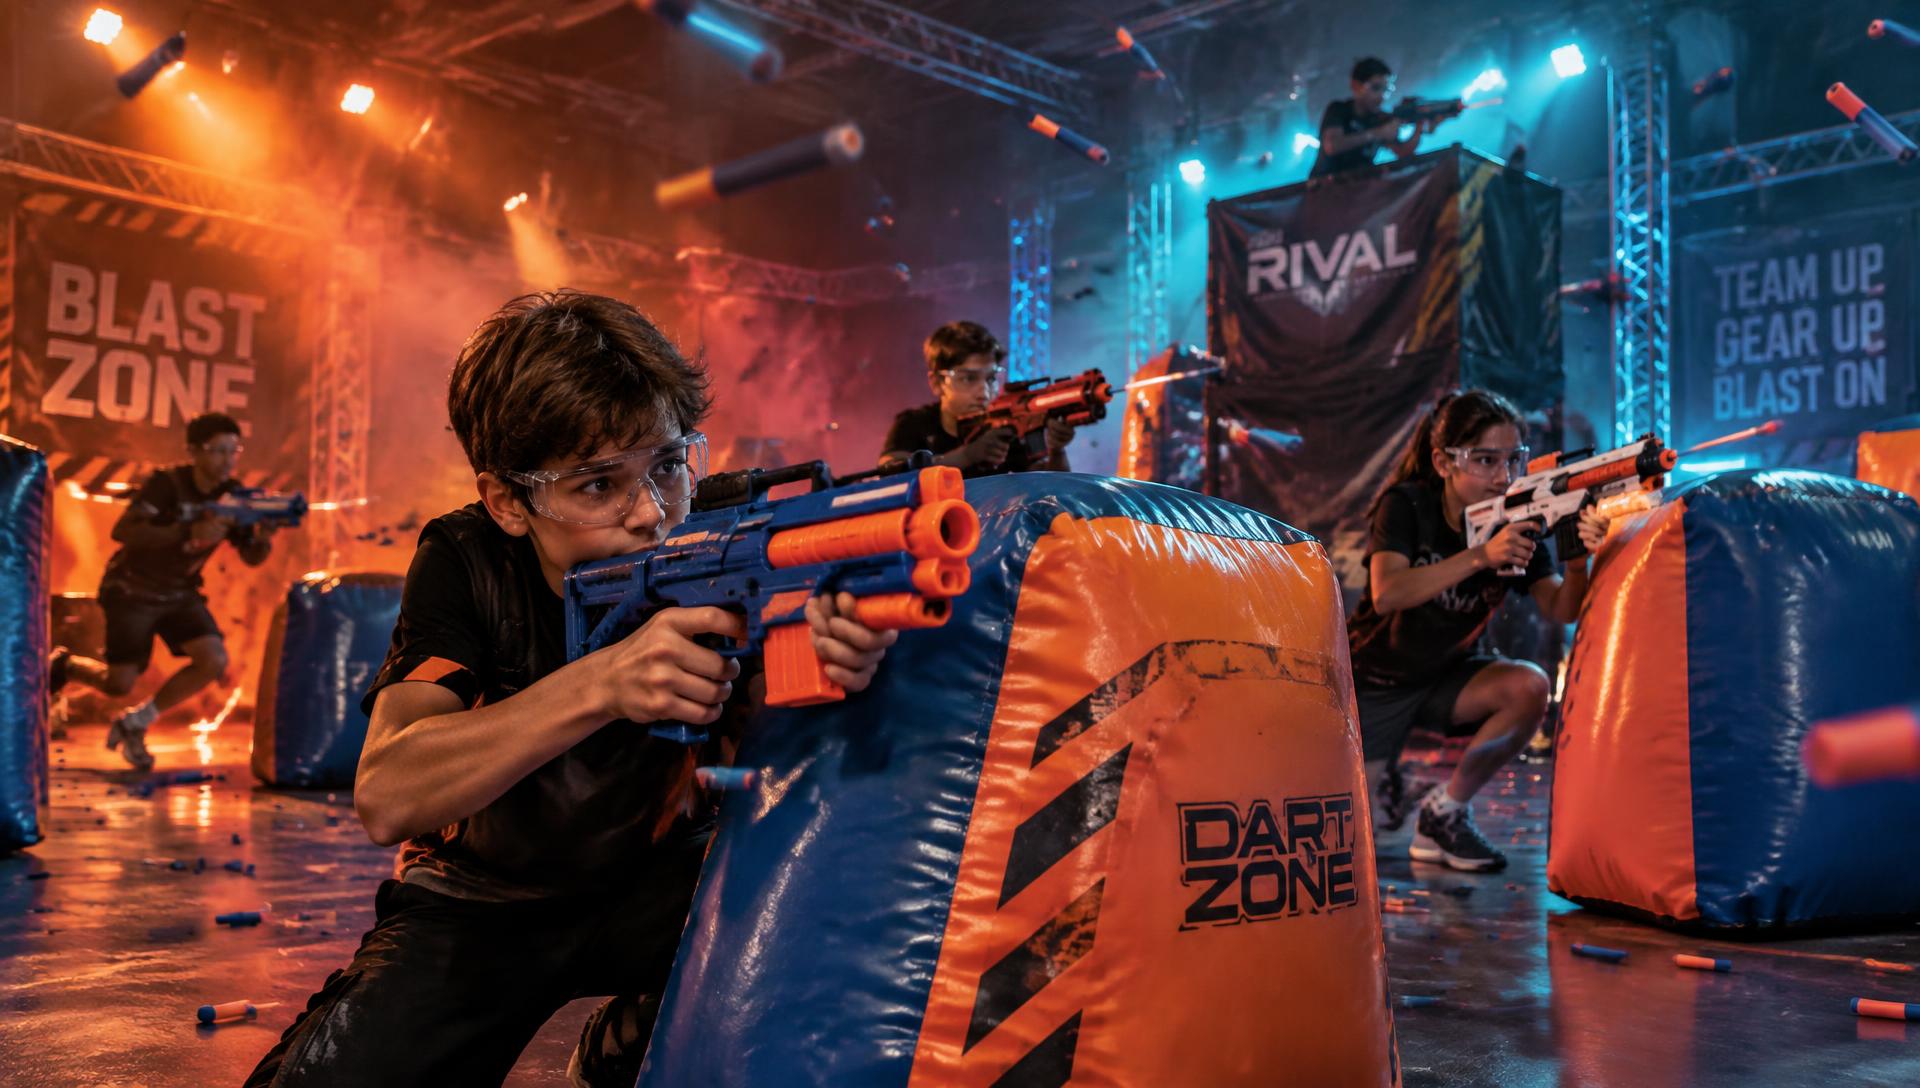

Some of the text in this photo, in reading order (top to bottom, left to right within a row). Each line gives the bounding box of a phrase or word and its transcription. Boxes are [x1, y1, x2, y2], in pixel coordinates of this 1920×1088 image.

[1247, 223, 1417, 295] RIVAL
[1712, 243, 1885, 312] TEAM UP
[47, 260, 267, 360] BLAST
[1714, 299, 1886, 368] GEAR UP
[41, 338, 255, 438] ZONE
[1713, 357, 1887, 421] BLAST ON
[1179, 795, 1354, 863] DART
[1181, 851, 1357, 926] ZONE
